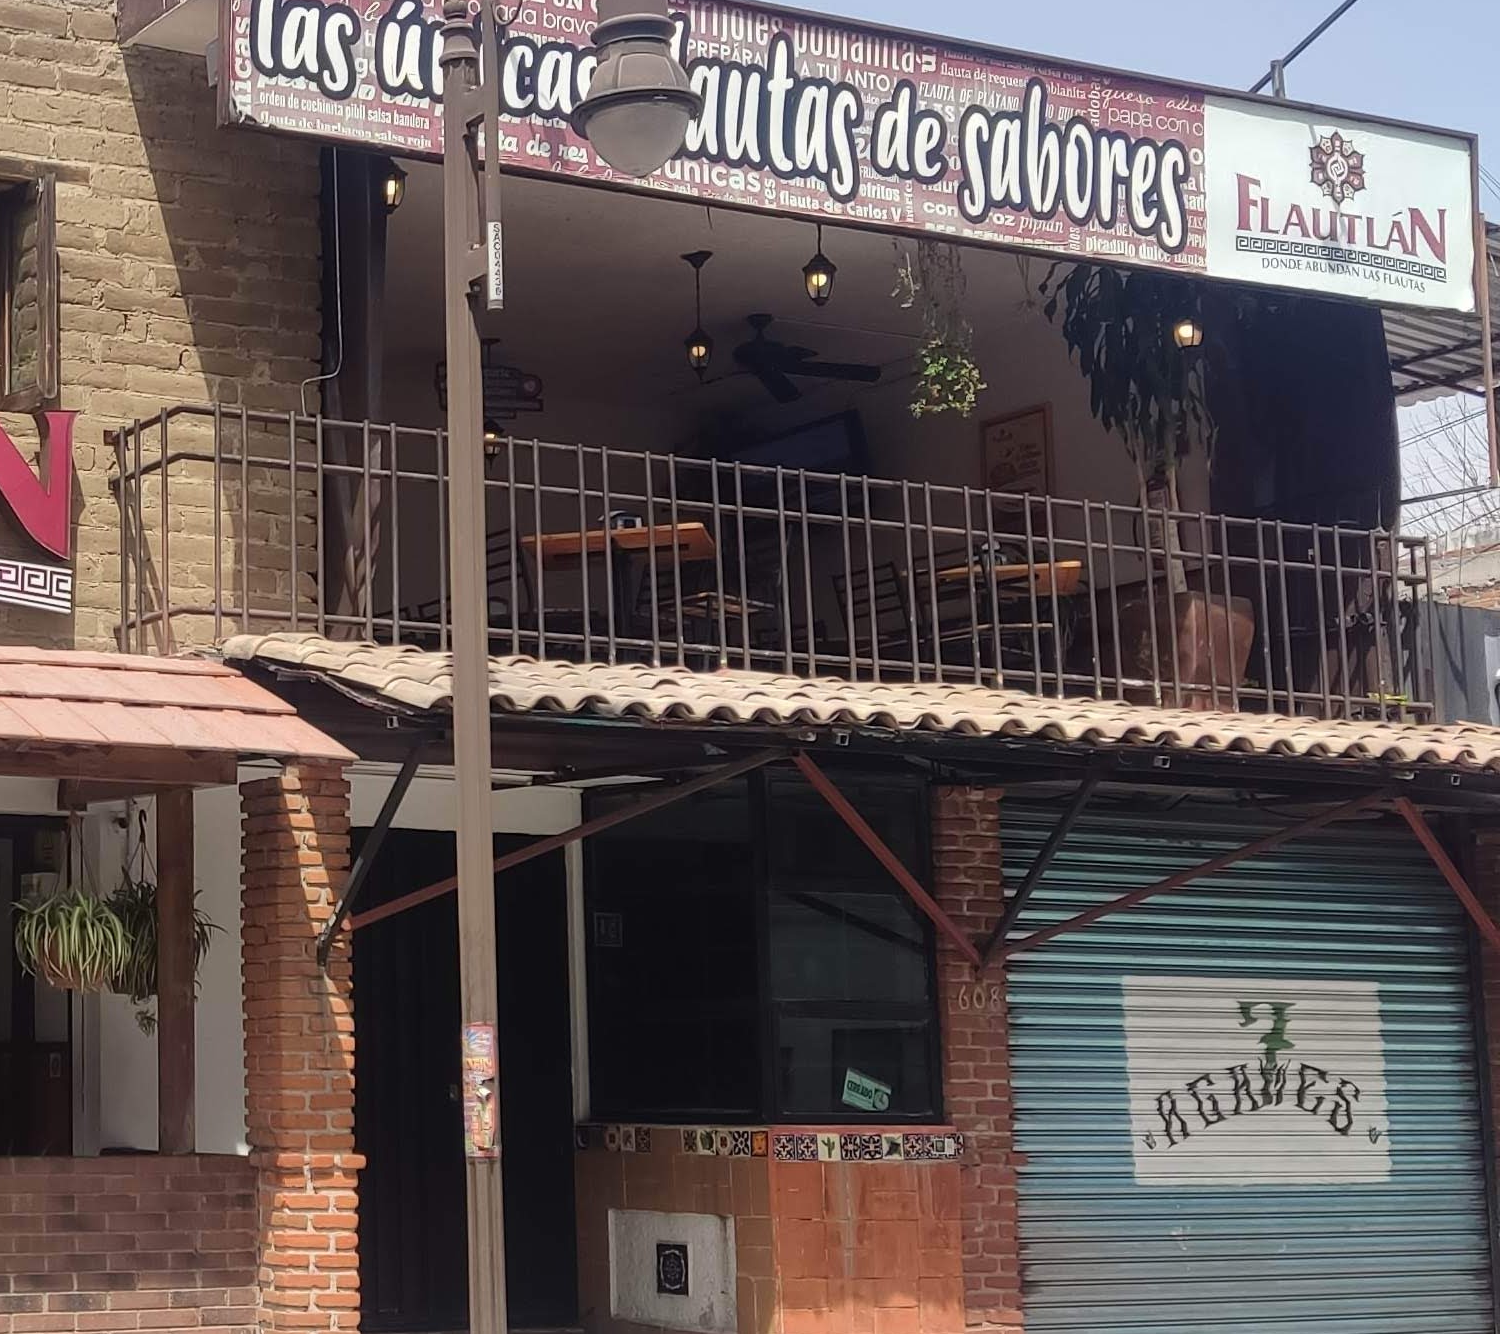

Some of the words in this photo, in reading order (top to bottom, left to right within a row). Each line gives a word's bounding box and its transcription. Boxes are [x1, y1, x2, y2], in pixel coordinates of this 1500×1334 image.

[816, 63, 837, 82] TU
[940, 63, 972, 80] flauta
[919, 81, 955, 102] FLAUTA
[960, 88, 972, 103] DE
[1101, 88, 1159, 109] queso
[260, 90, 286, 108] orden
[288, 93, 299, 109] de
[301, 97, 343, 117] cochinita
[345, 103, 366, 121] pibil
[367, 108, 392, 124] salsa
[393, 111, 430, 130] bandera
[1108, 107, 1153, 128] papa
[1156, 115, 1189, 134] con
[375, 129, 405, 145] salsa
[526, 133, 550, 157] de
[558, 143, 589, 164] res
[877, 87, 942, 177] de
[963, 85, 1185, 247] sabores
[780, 190, 820, 211] flauta
[846, 202, 888, 221] Carlos
[890, 207, 902, 223] V
[923, 202, 959, 217] con
[1236, 173, 1447, 264] FLAUTLÁN
[1085, 235, 1136, 257] picadillo
[1262, 257, 1303, 271] DONDE
[1305, 260, 1360, 278] ABUNDAN
[1363, 269, 1381, 283] LAS
[1383, 272, 1426, 293] FLAUTAS
[958, 984, 1001, 1011] 608
[1154, 1058, 1361, 1149] AGAVES
